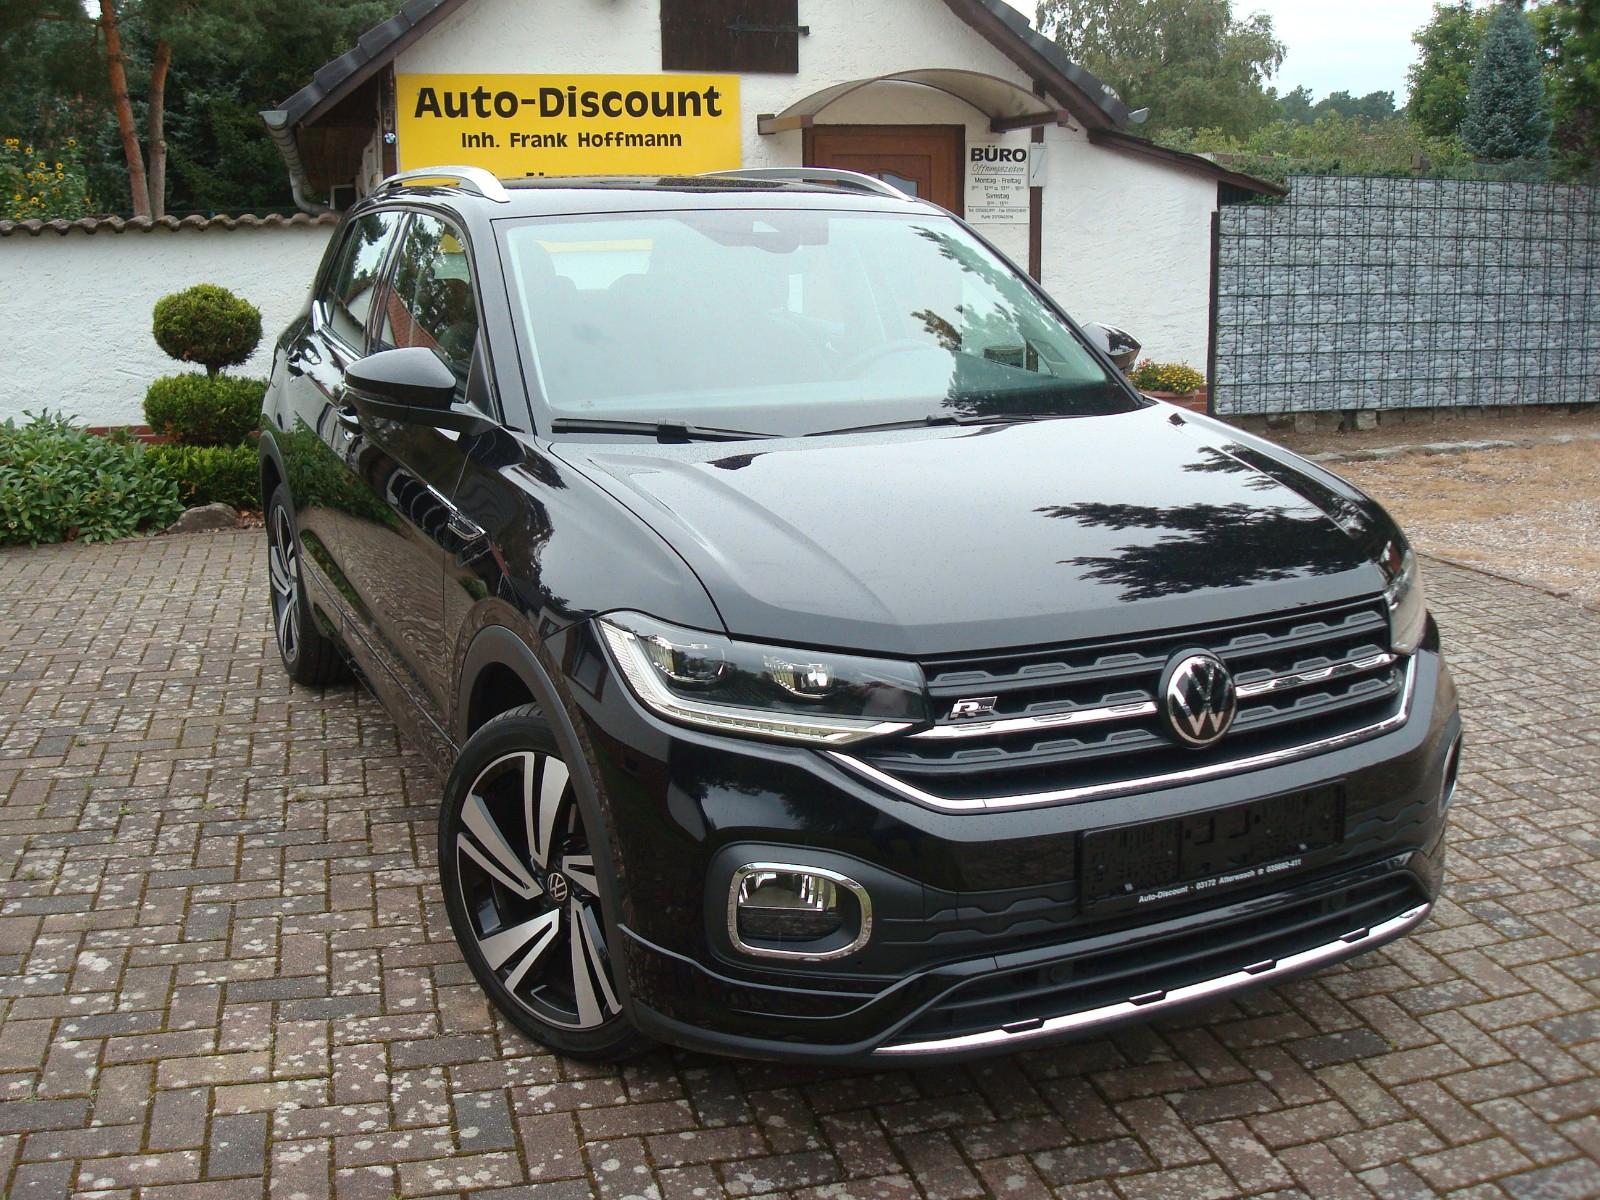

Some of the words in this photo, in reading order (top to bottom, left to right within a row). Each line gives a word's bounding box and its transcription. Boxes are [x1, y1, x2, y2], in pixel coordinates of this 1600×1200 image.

[414, 86, 723, 118] Auto-Discount
[461, 132, 500, 148] Inh.
[510, 132, 568, 148] Frank
[577, 131, 682, 148] Hoffmann
[970, 145, 1027, 162] BÜRO
[985, 192, 1010, 200] Samstag
[1138, 885, 1189, 903] Auto-Discount
[1195, 879, 1217, 890] 03172
